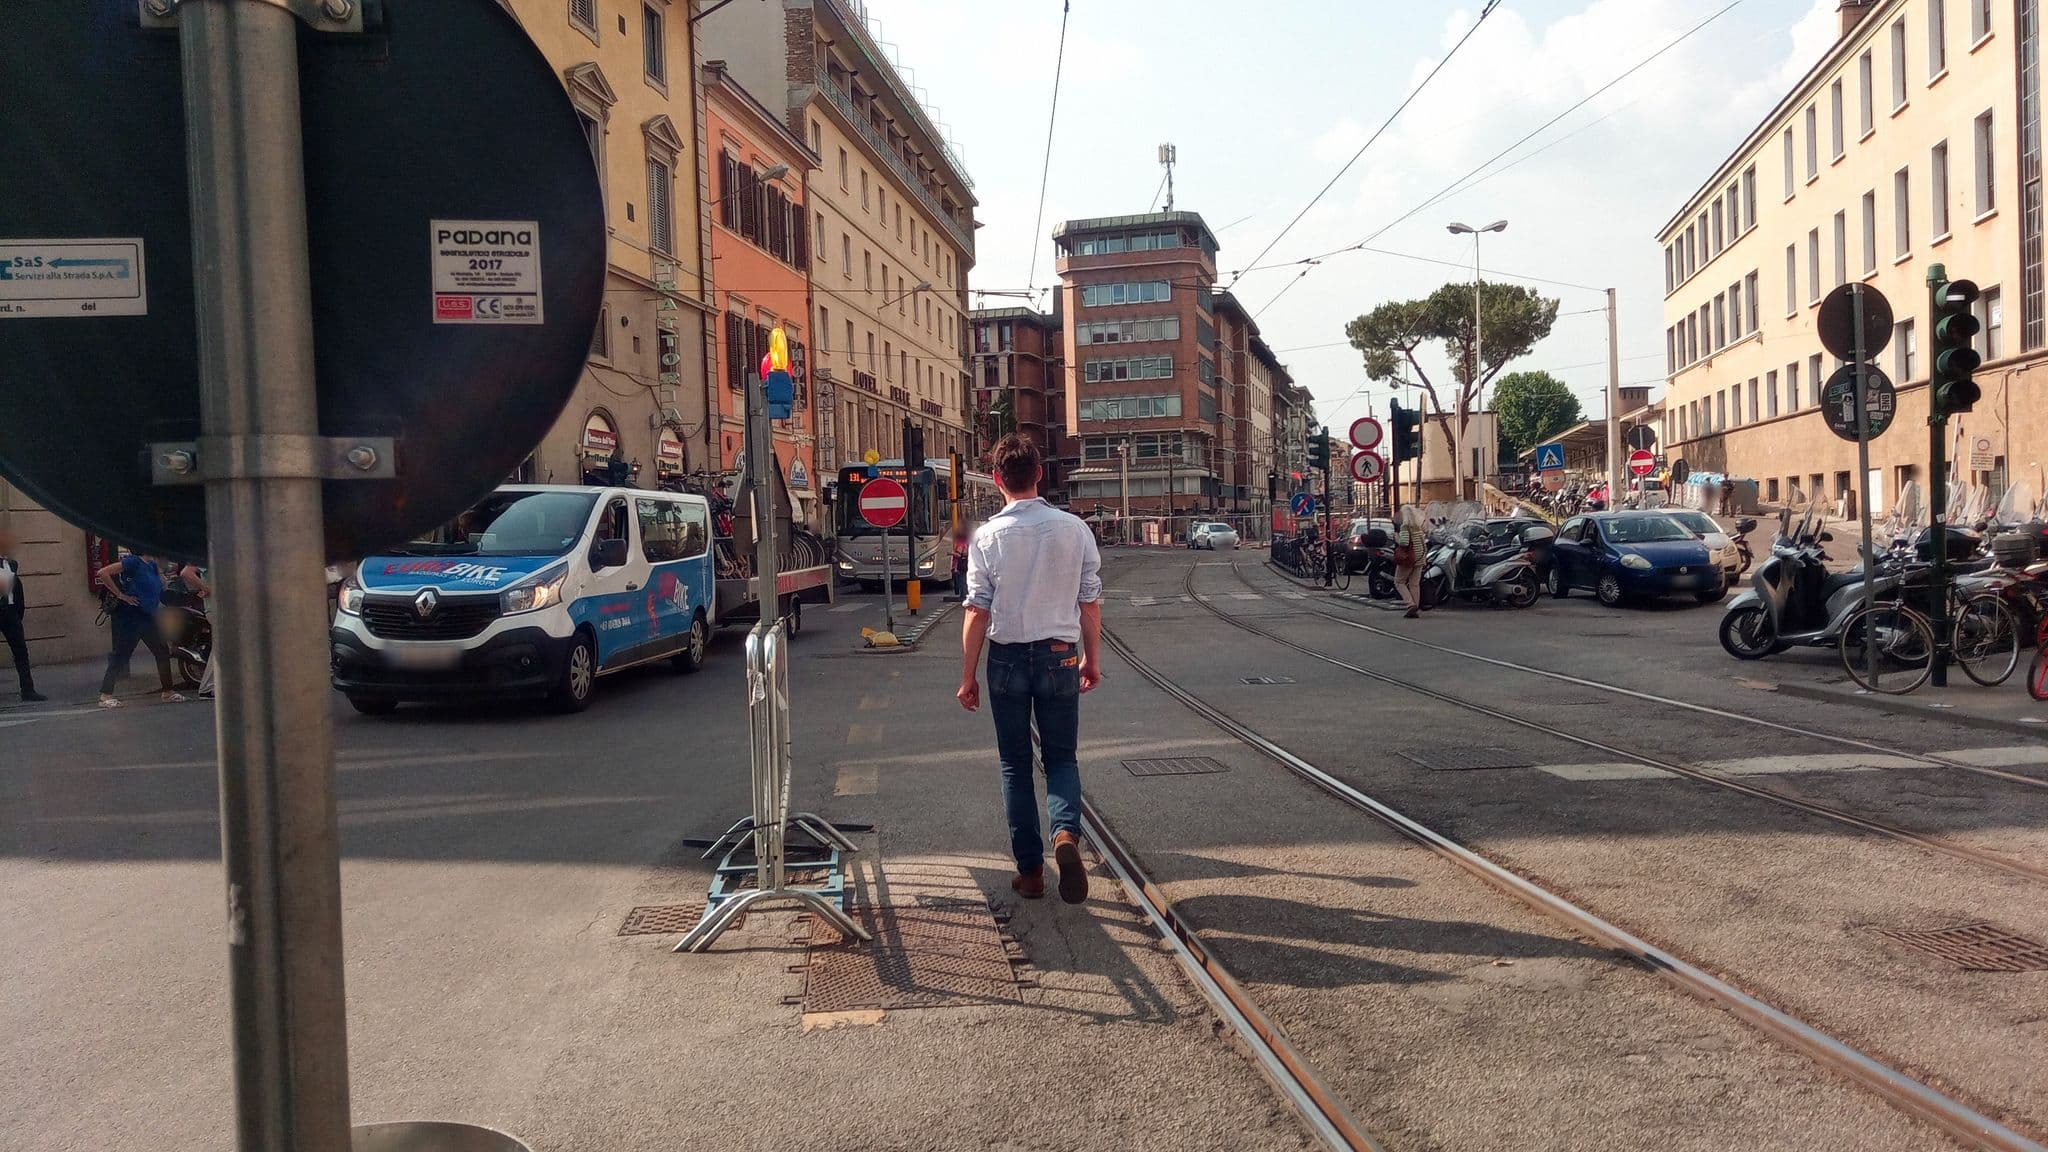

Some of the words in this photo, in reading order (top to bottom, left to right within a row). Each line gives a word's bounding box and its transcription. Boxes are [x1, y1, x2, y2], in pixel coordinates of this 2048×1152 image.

[14, 256, 43, 267] SaS
[469, 259, 502, 270] 2017
[15, 272, 44, 280] Servizi
[46, 271, 62, 280] alla
[63, 271, 90, 279] Strada
[81, 303, 96, 311] del
[477, 299, 500, 314] CE
[655, 262, 681, 421] TRATTORIA
[849, 473, 860, 482] 131
